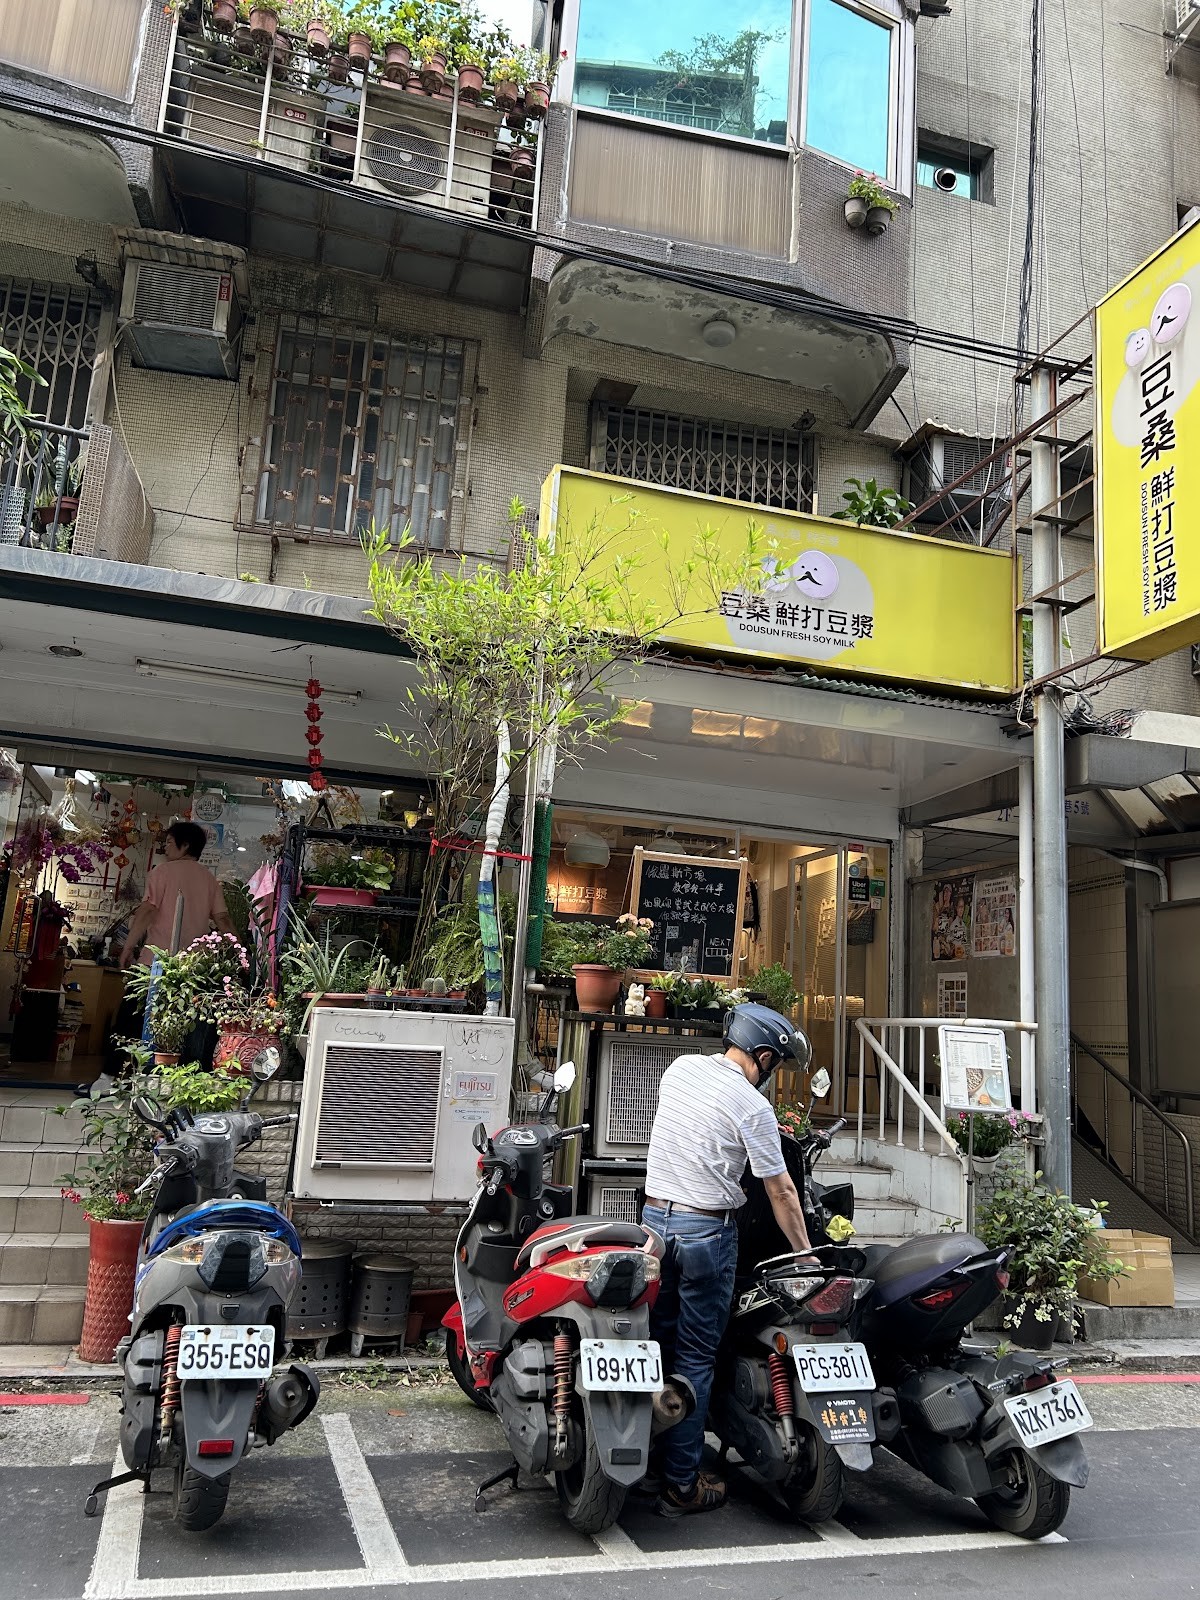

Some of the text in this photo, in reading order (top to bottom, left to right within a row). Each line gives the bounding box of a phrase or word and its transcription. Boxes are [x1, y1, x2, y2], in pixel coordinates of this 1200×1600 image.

[221, 288, 228, 299] 日立
[1150, 466, 1177, 612] 鮮打豆漿
[739, 623, 855, 648] DOUSUN FRESH SOY MILK
[471, 824, 477, 834] 5
[709, 938, 731, 946] NEXT
[460, 1077, 491, 1092] FUJITSU
